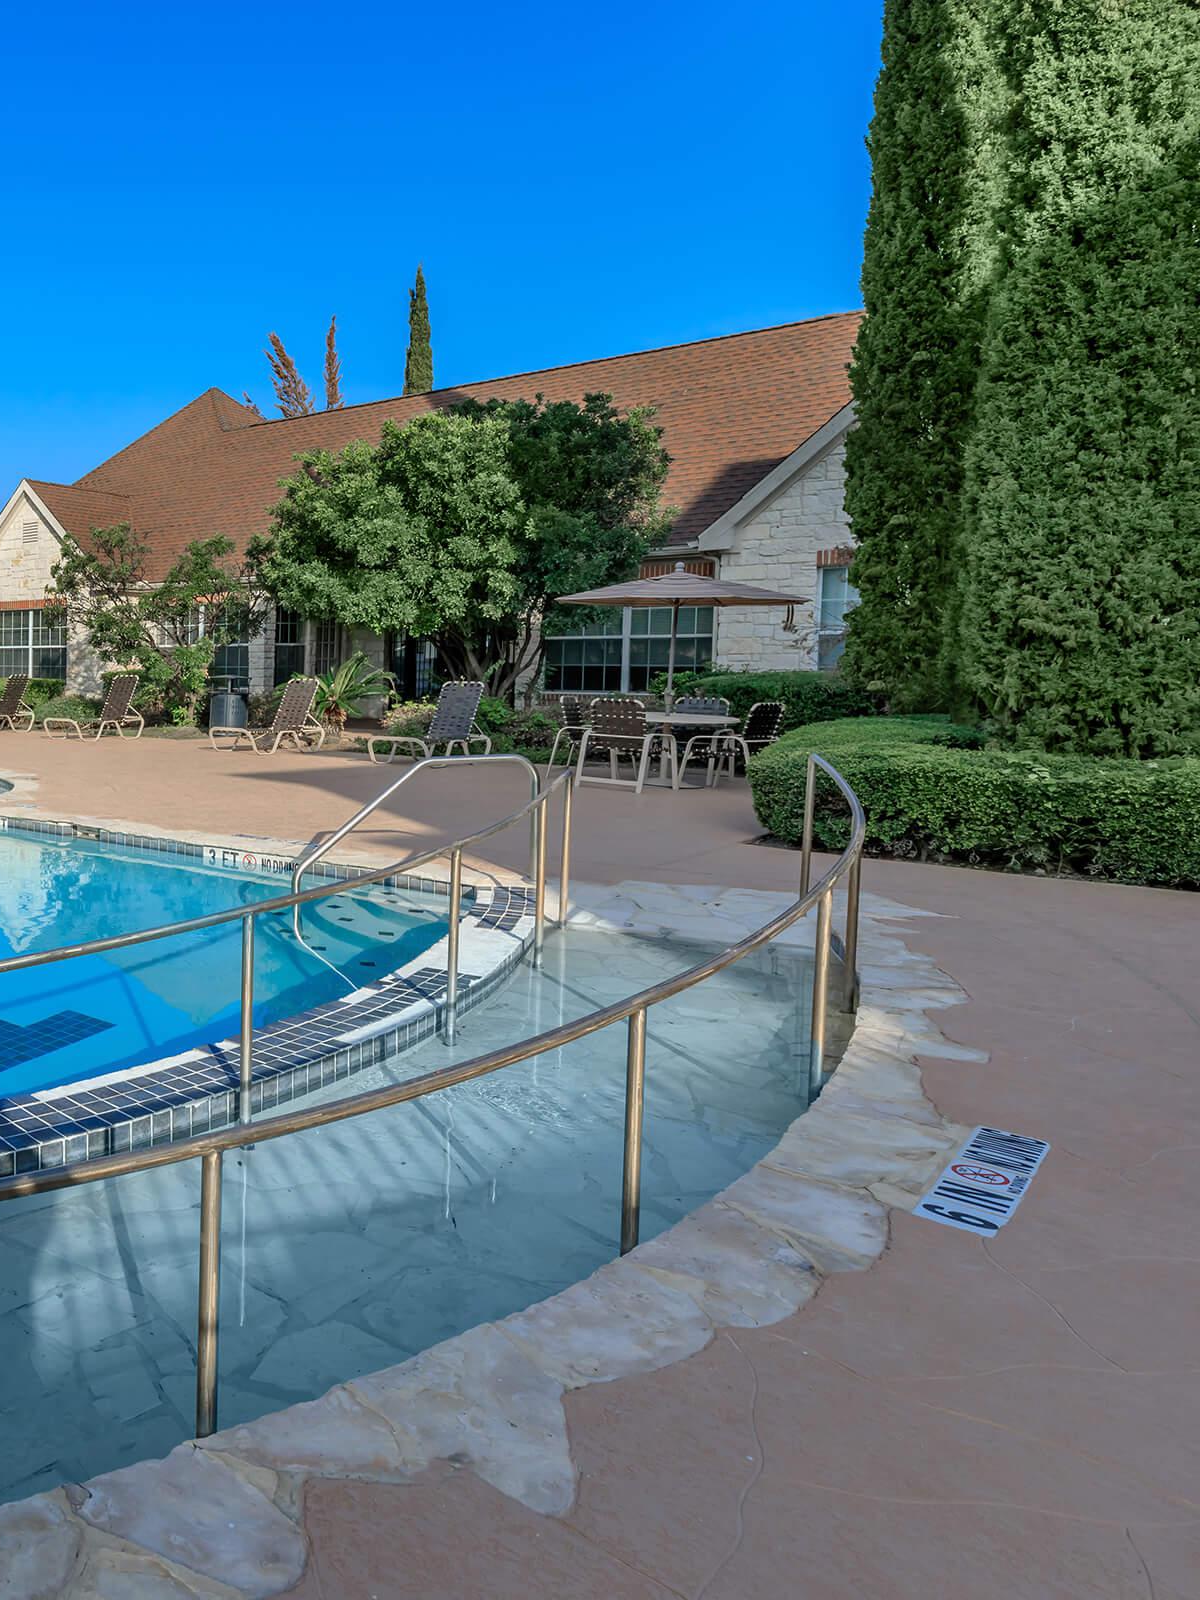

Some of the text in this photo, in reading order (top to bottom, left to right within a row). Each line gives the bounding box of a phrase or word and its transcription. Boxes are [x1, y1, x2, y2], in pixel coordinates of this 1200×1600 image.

[209, 848, 216, 866] 3
[222, 851, 239, 870] FT
[261, 857, 271, 873] NO
[922, 1127, 1048, 1230] 6 IN NO DIVING
